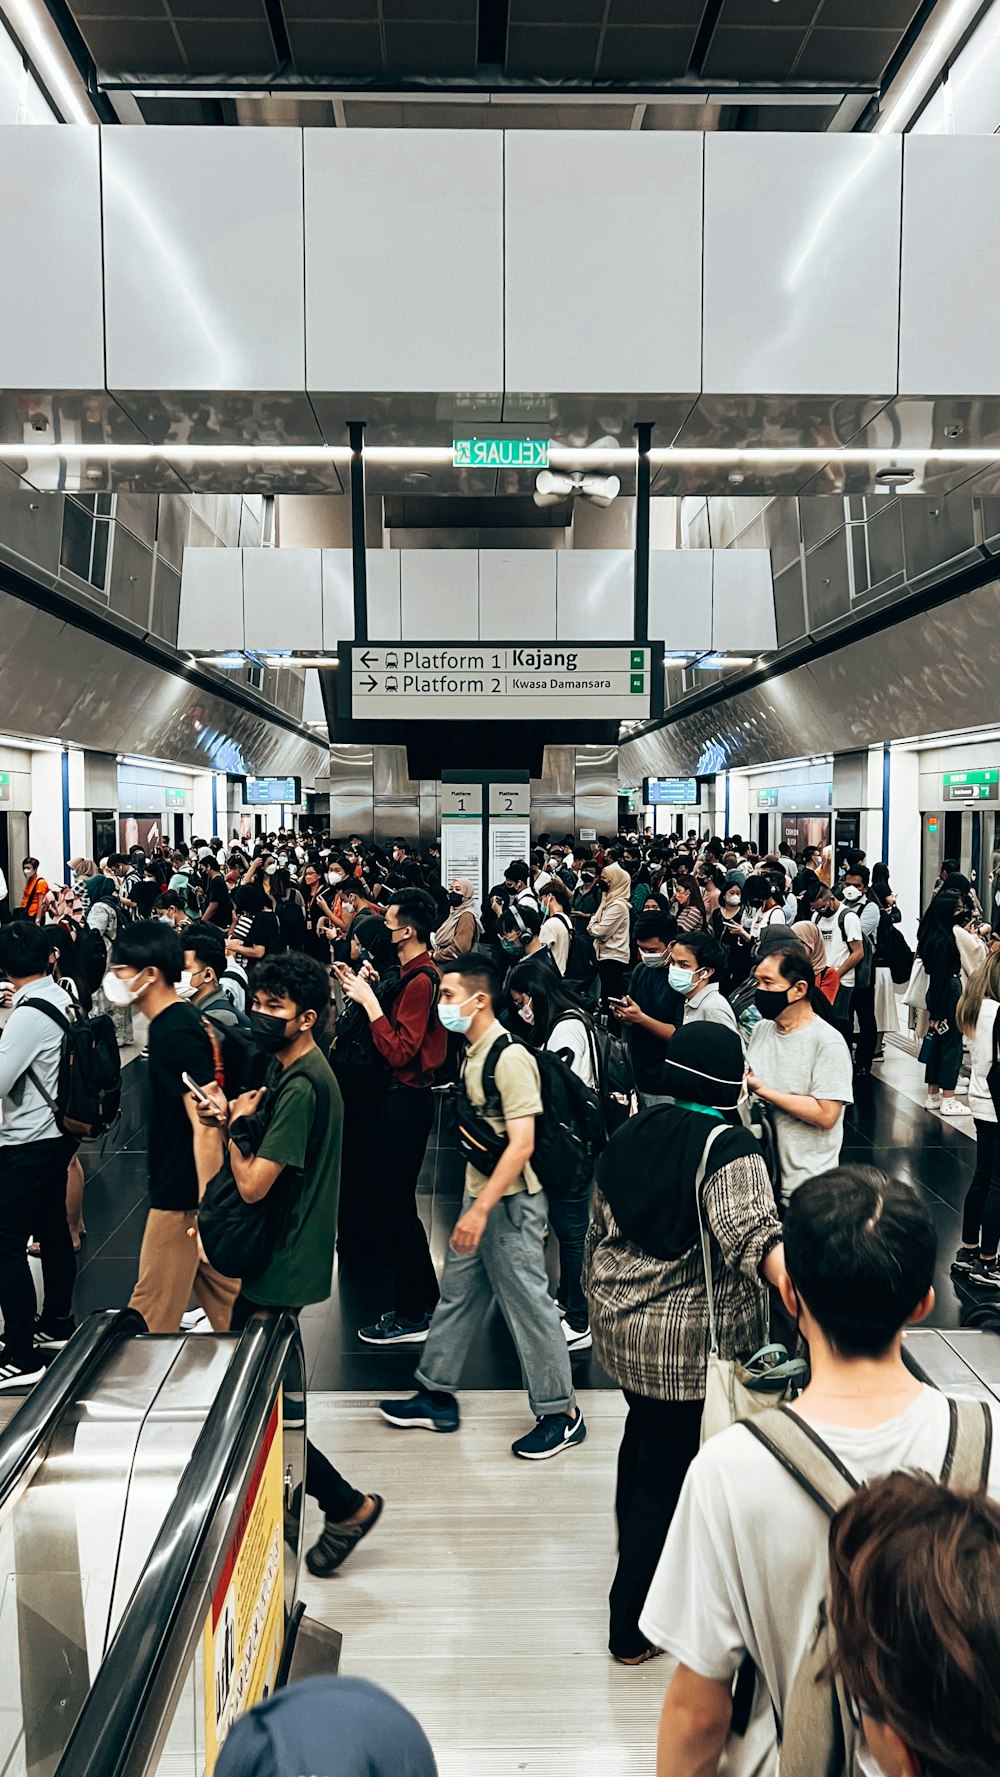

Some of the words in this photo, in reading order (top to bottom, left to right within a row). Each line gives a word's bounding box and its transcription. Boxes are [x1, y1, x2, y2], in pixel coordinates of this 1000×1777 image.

[403, 652, 484, 669] Platform
[491, 654, 501, 669] 1
[512, 649, 578, 671] Kajang
[403, 675, 484, 692] Platform
[491, 678, 501, 693] 2
[512, 679, 547, 689] Kwasa
[550, 679, 611, 689] Damansara
[458, 799, 466, 811] 1
[505, 799, 513, 811] 2
